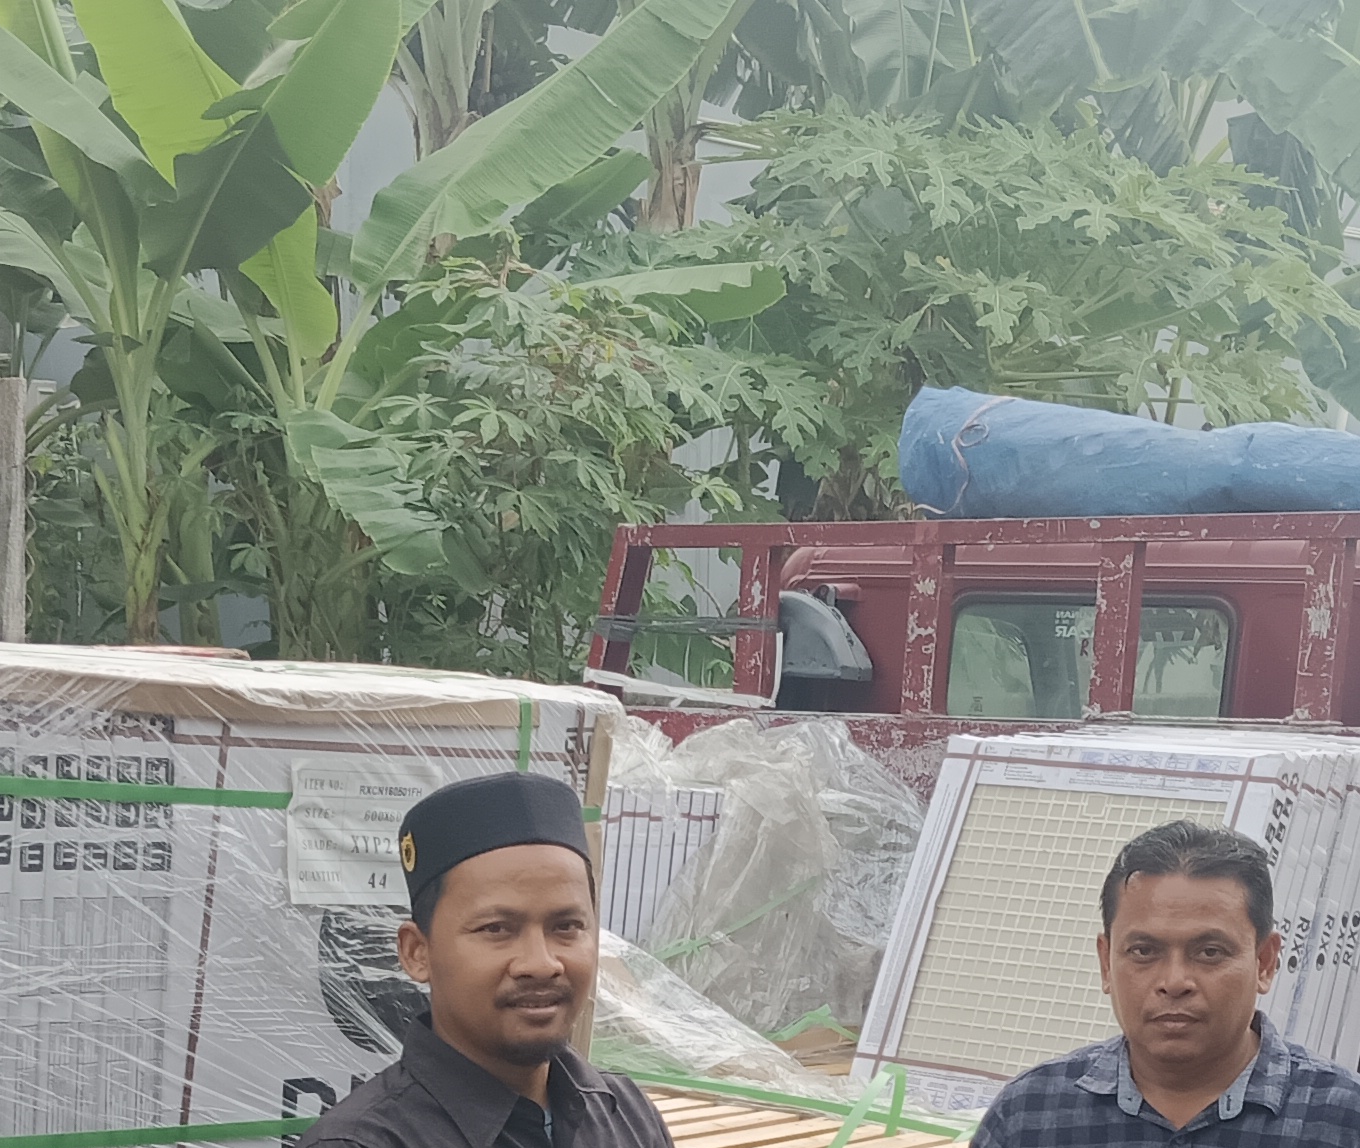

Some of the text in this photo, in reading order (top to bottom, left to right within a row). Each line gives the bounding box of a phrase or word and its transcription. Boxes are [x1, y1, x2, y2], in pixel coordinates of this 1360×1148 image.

[363, 810, 403, 823] 600X60
[350, 834, 400, 855] XYP2
[298, 871, 340, 883] QUANTITY
[367, 872, 388, 889] 44
